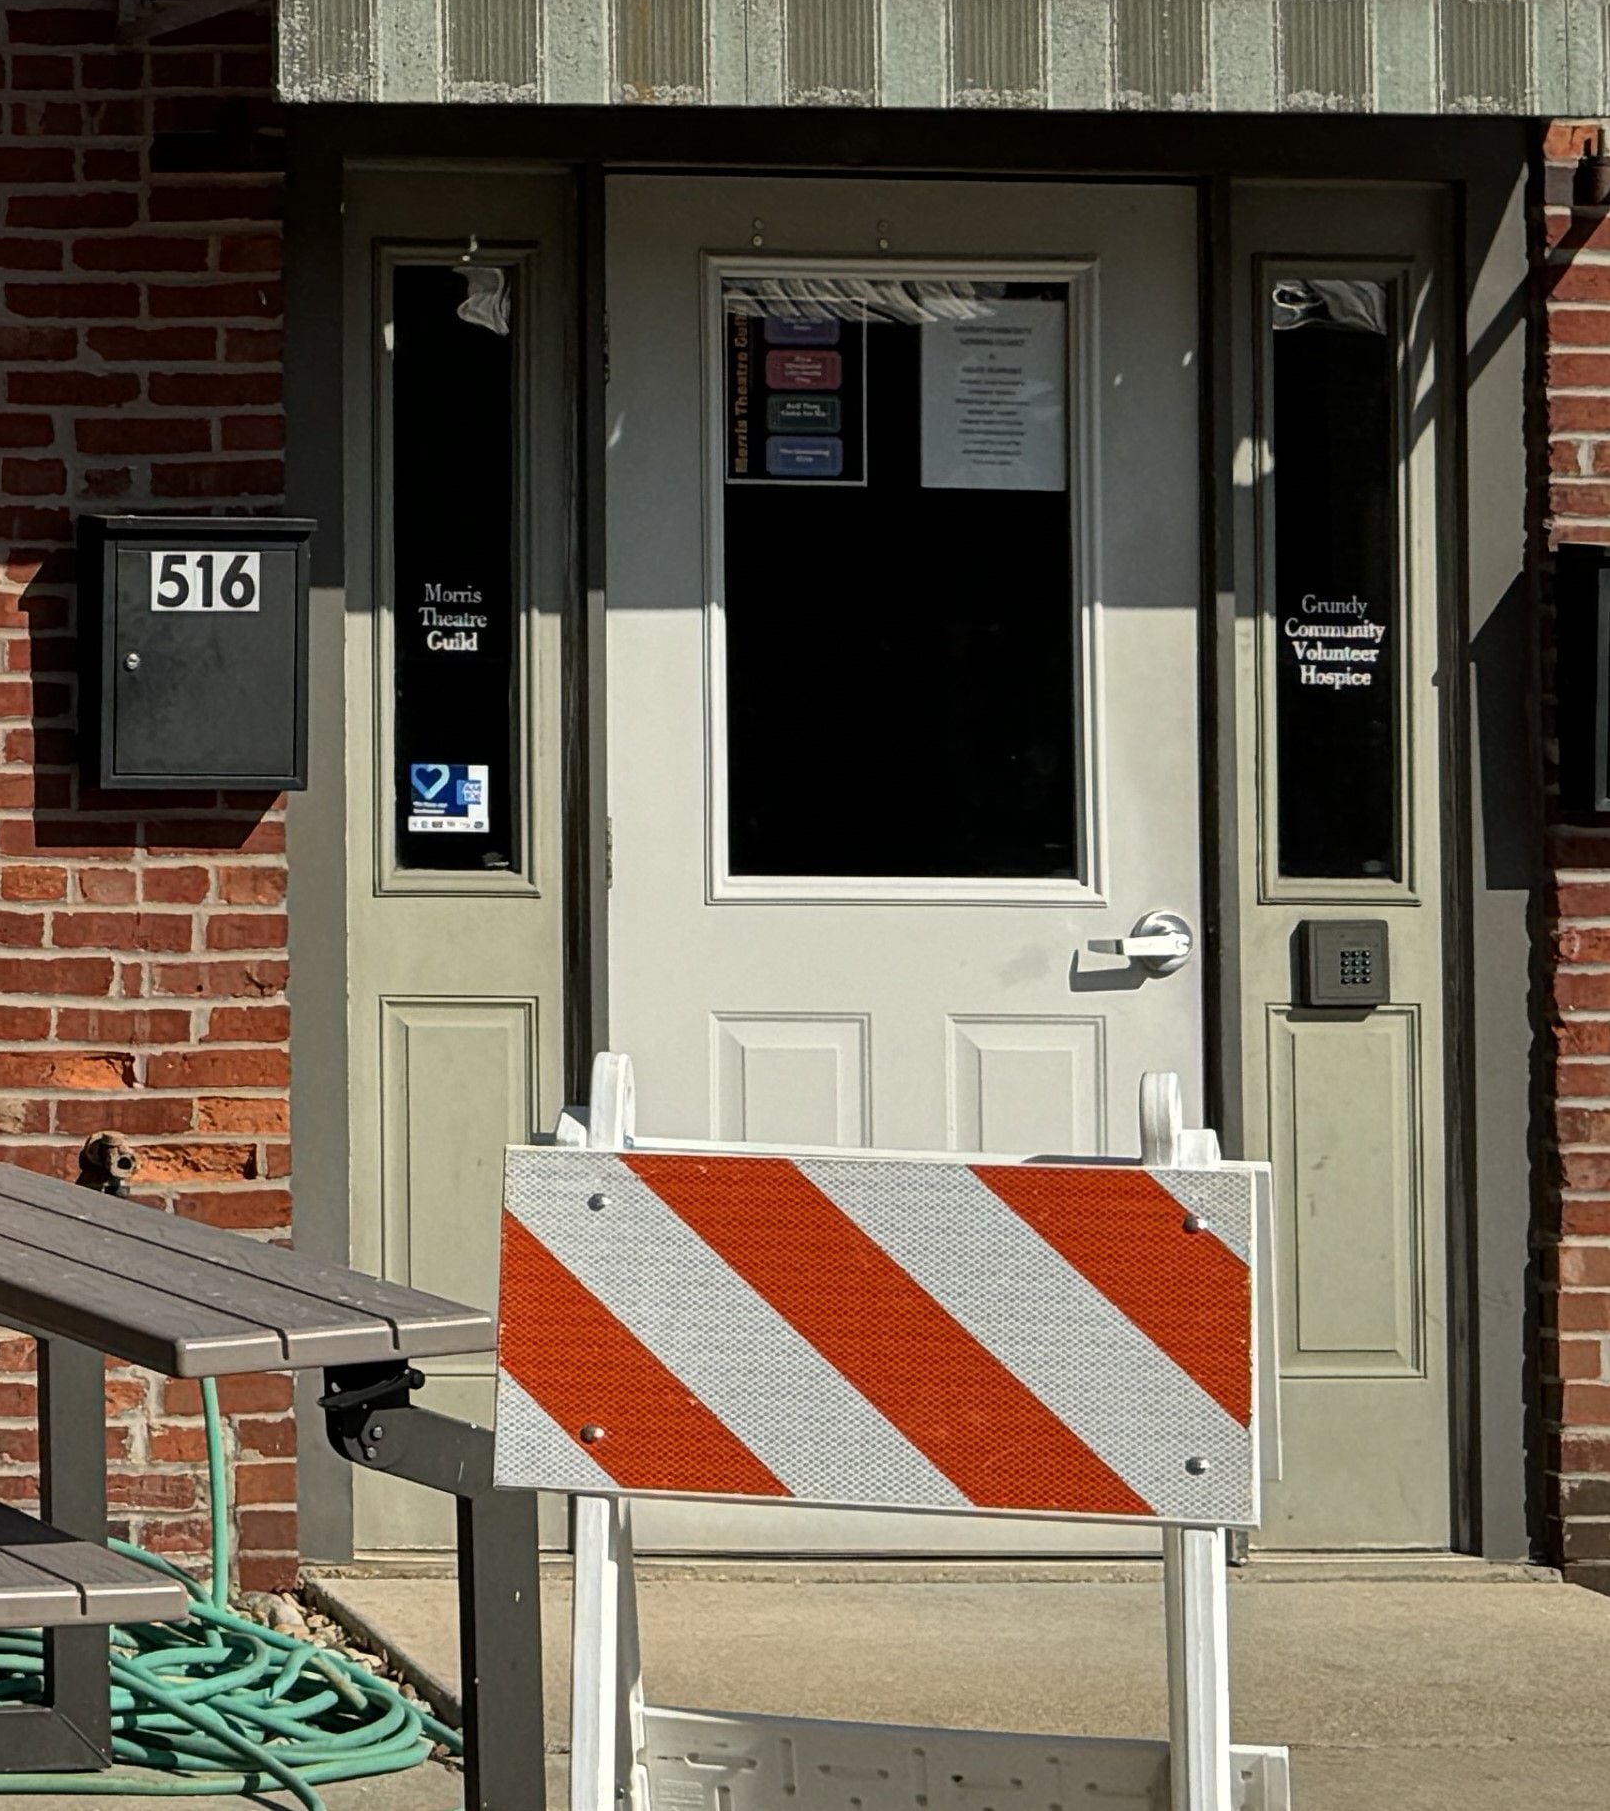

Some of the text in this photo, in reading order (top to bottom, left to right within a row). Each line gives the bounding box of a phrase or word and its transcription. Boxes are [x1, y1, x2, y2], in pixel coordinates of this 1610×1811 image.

[157, 554, 255, 608] 516
[424, 582, 483, 604] Morris
[417, 606, 488, 628] Theatre
[1301, 594, 1368, 619] Grundy
[426, 629, 479, 651] Guild
[1284, 617, 1386, 644] Community
[1291, 640, 1380, 662] Volunteer
[1299, 664, 1372, 690] Hospice
